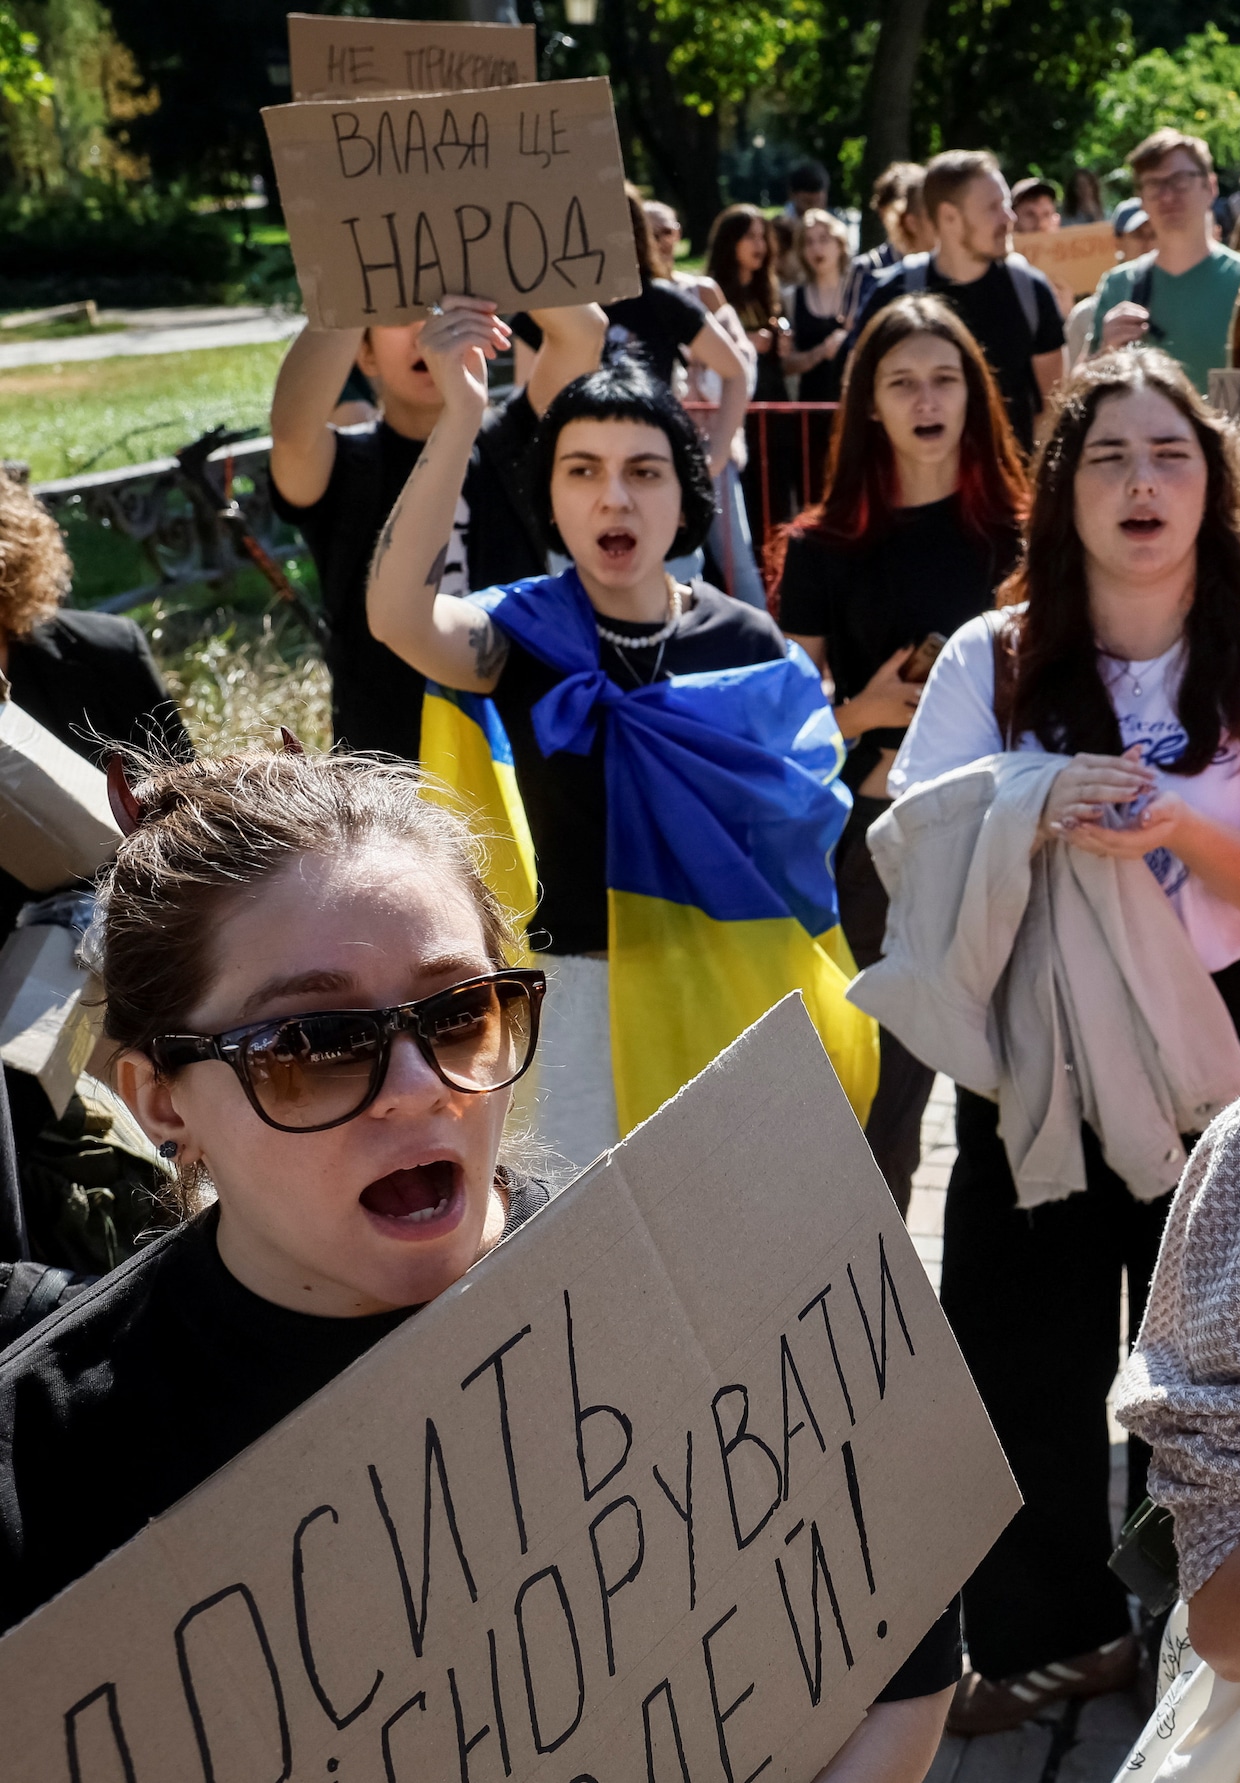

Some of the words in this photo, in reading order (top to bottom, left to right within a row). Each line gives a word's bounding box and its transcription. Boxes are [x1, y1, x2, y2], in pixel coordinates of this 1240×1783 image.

[327, 44, 388, 84] НЕ
[331, 108, 490, 178] ВЛАДА
[518, 108, 571, 169] ЦЕ
[341, 194, 606, 314] НАРОД
